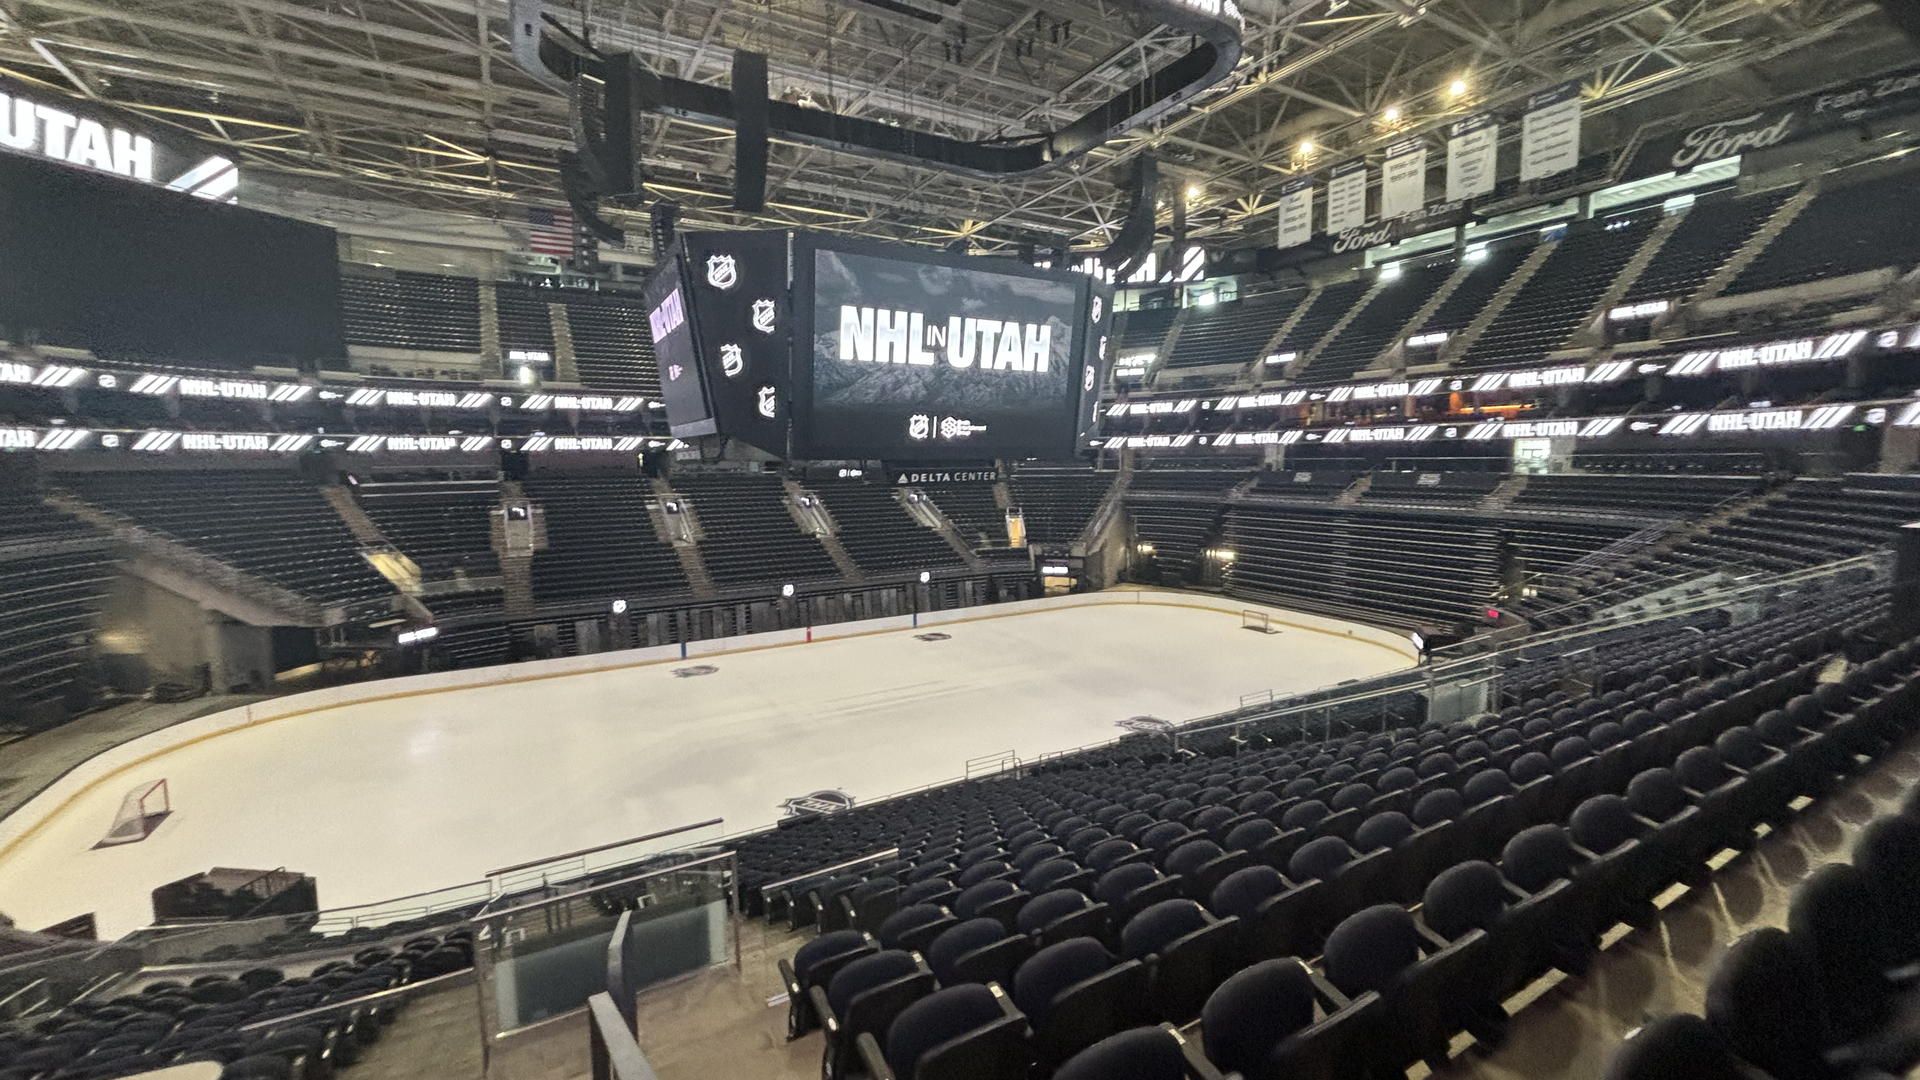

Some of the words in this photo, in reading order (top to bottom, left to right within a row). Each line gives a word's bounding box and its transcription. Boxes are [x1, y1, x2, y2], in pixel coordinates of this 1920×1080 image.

[1671, 112, 1795, 167] Ford
[1333, 220, 1393, 253] Ford
[839, 305, 935, 366] NHL
[926, 324, 947, 348] IN
[947, 316, 1052, 374] UTAH
[911, 472, 950, 483] DELTA
[954, 471, 997, 482] CENTER
